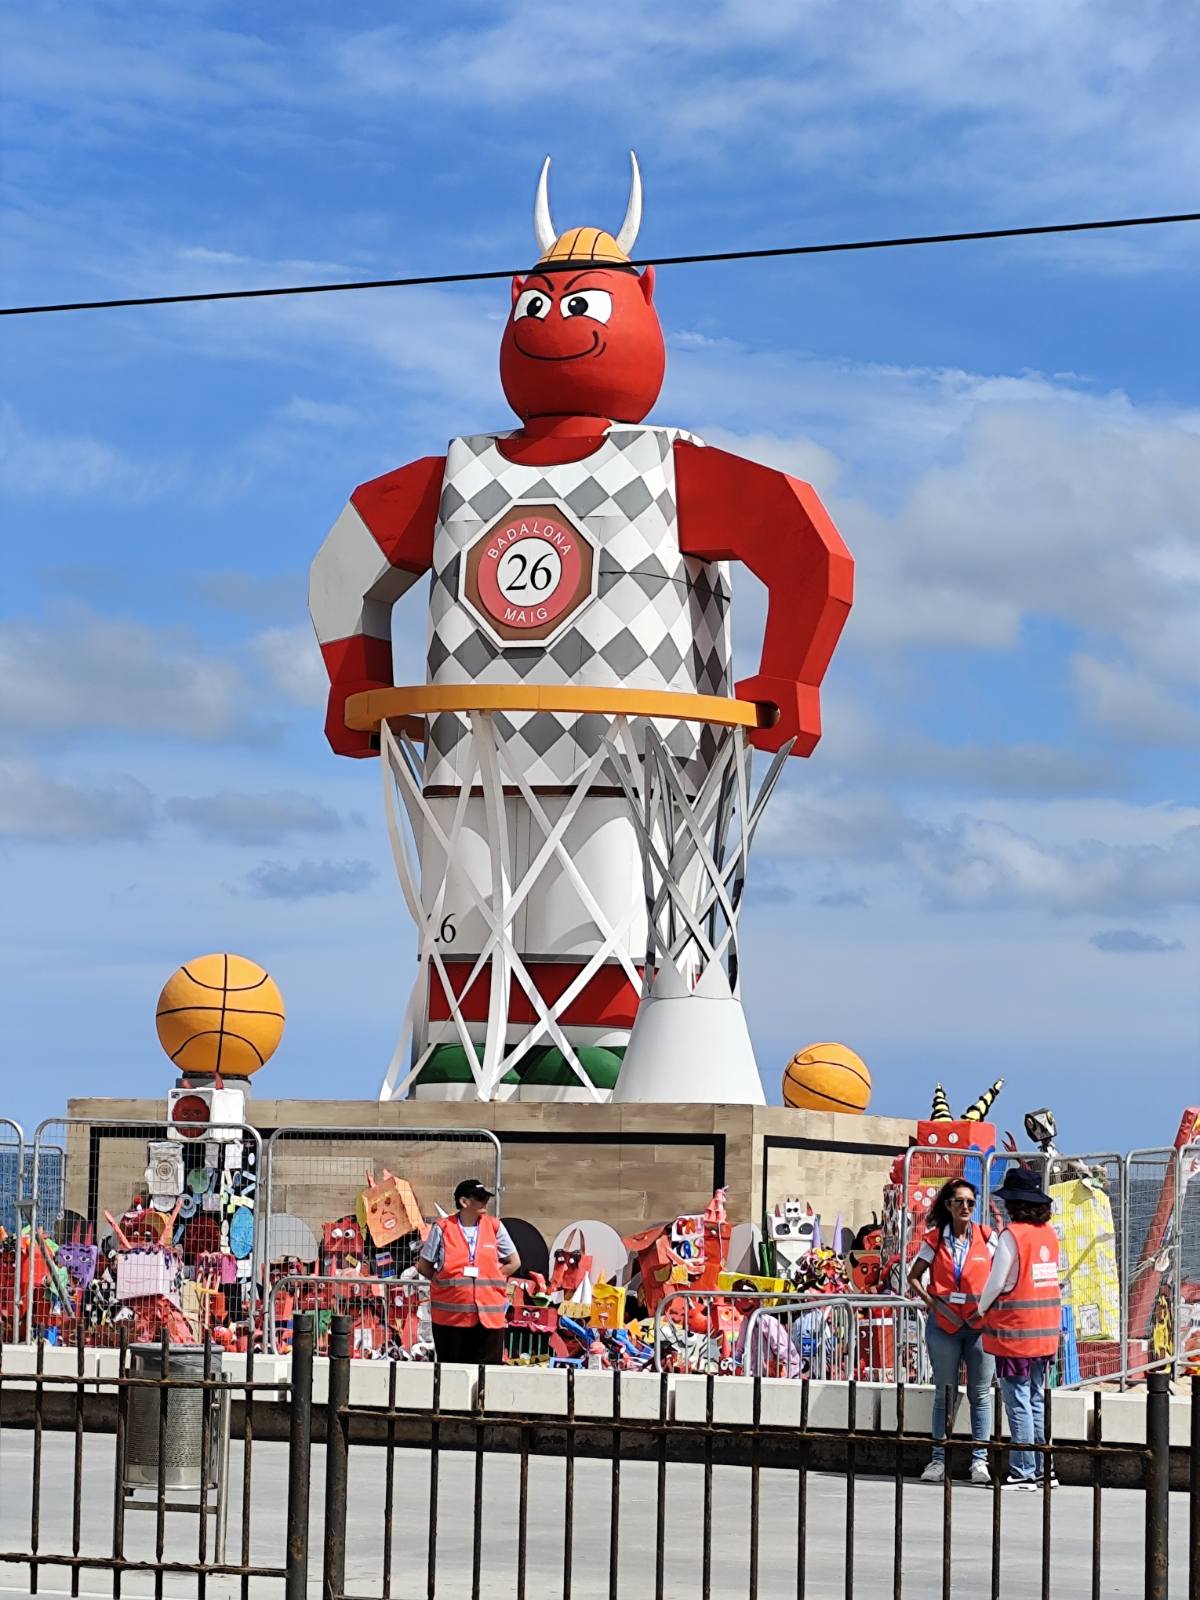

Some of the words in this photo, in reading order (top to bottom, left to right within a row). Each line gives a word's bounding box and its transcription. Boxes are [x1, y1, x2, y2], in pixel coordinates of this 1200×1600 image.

[487, 521, 572, 559] BADALONA
[505, 552, 554, 591] 26
[503, 607, 548, 623] MAIG
